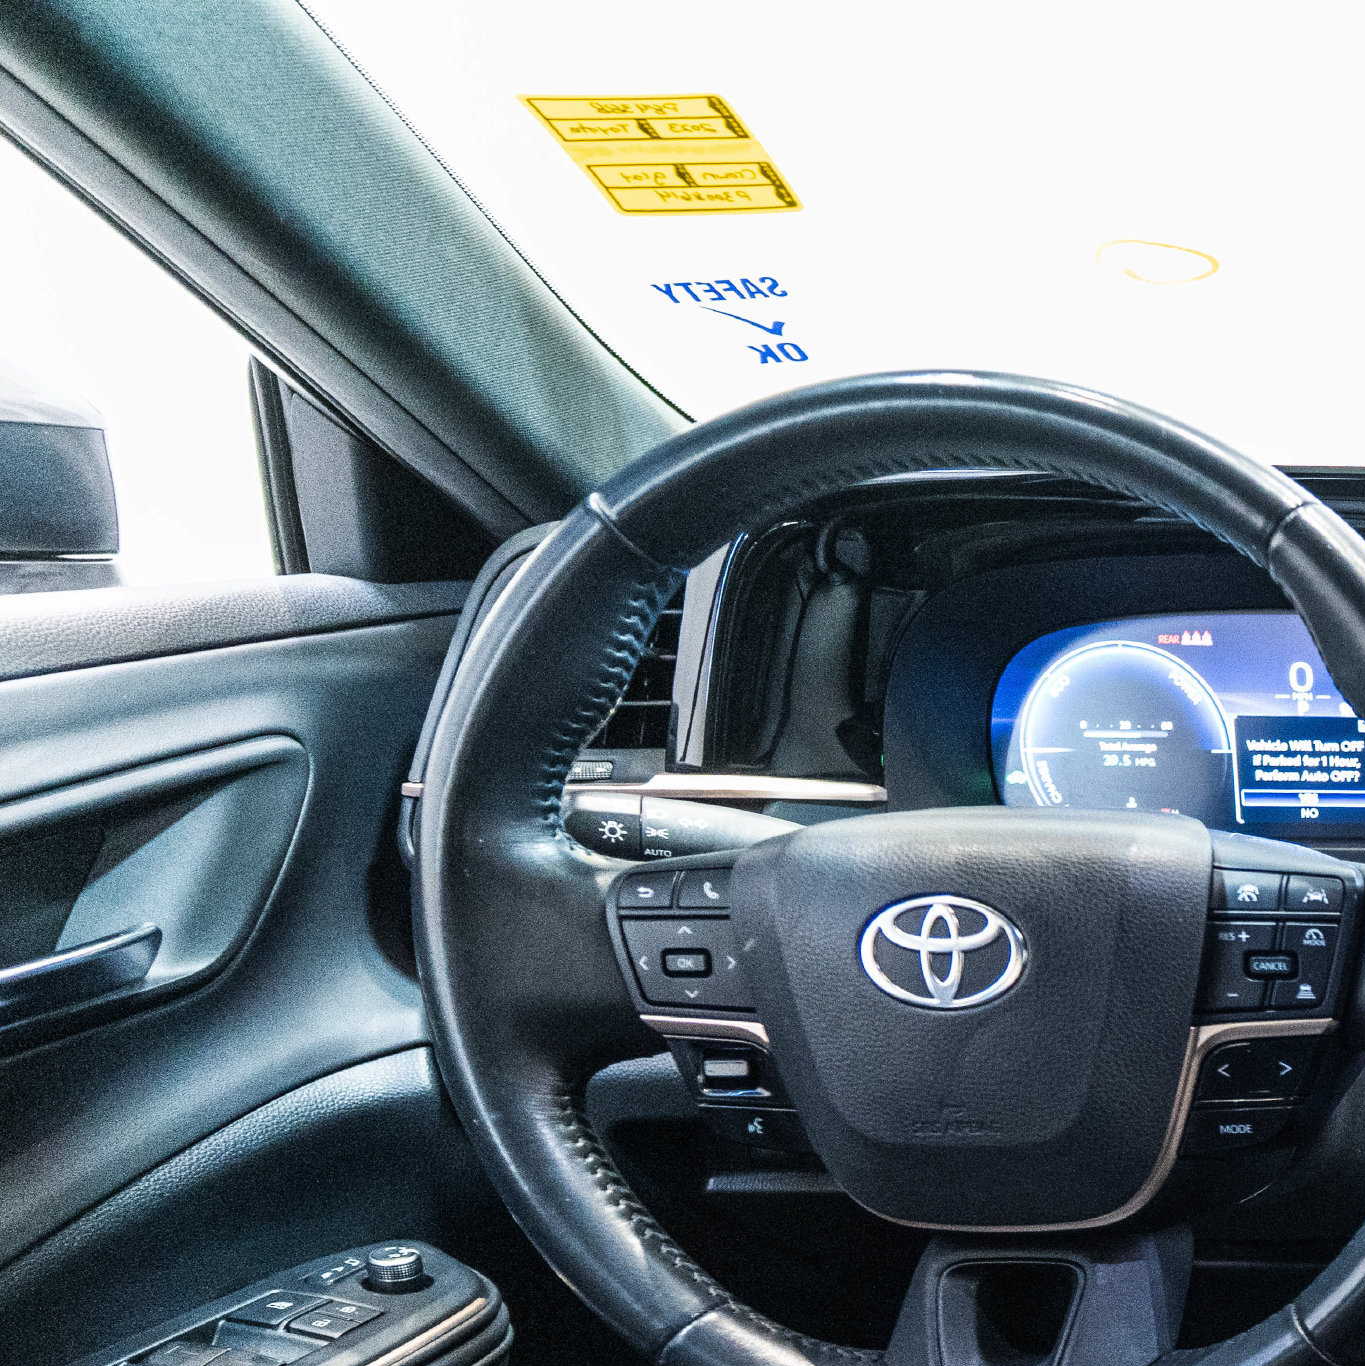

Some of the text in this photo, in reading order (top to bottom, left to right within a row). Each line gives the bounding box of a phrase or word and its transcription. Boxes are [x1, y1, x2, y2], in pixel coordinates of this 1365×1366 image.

[1158, 634, 1180, 645] REAR
[1246, 739, 1365, 752] Vehicle Will Turn OFF
[1263, 755, 1301, 766] Parked
[1302, 755, 1320, 767] for
[1255, 770, 1300, 781] Perform
[1301, 770, 1329, 782] Auto
[1300, 808, 1319, 819] NO
[644, 848, 672, 858] AUTO
[1252, 961, 1288, 971] CANCEL
[1219, 1124, 1253, 1135] MODE
